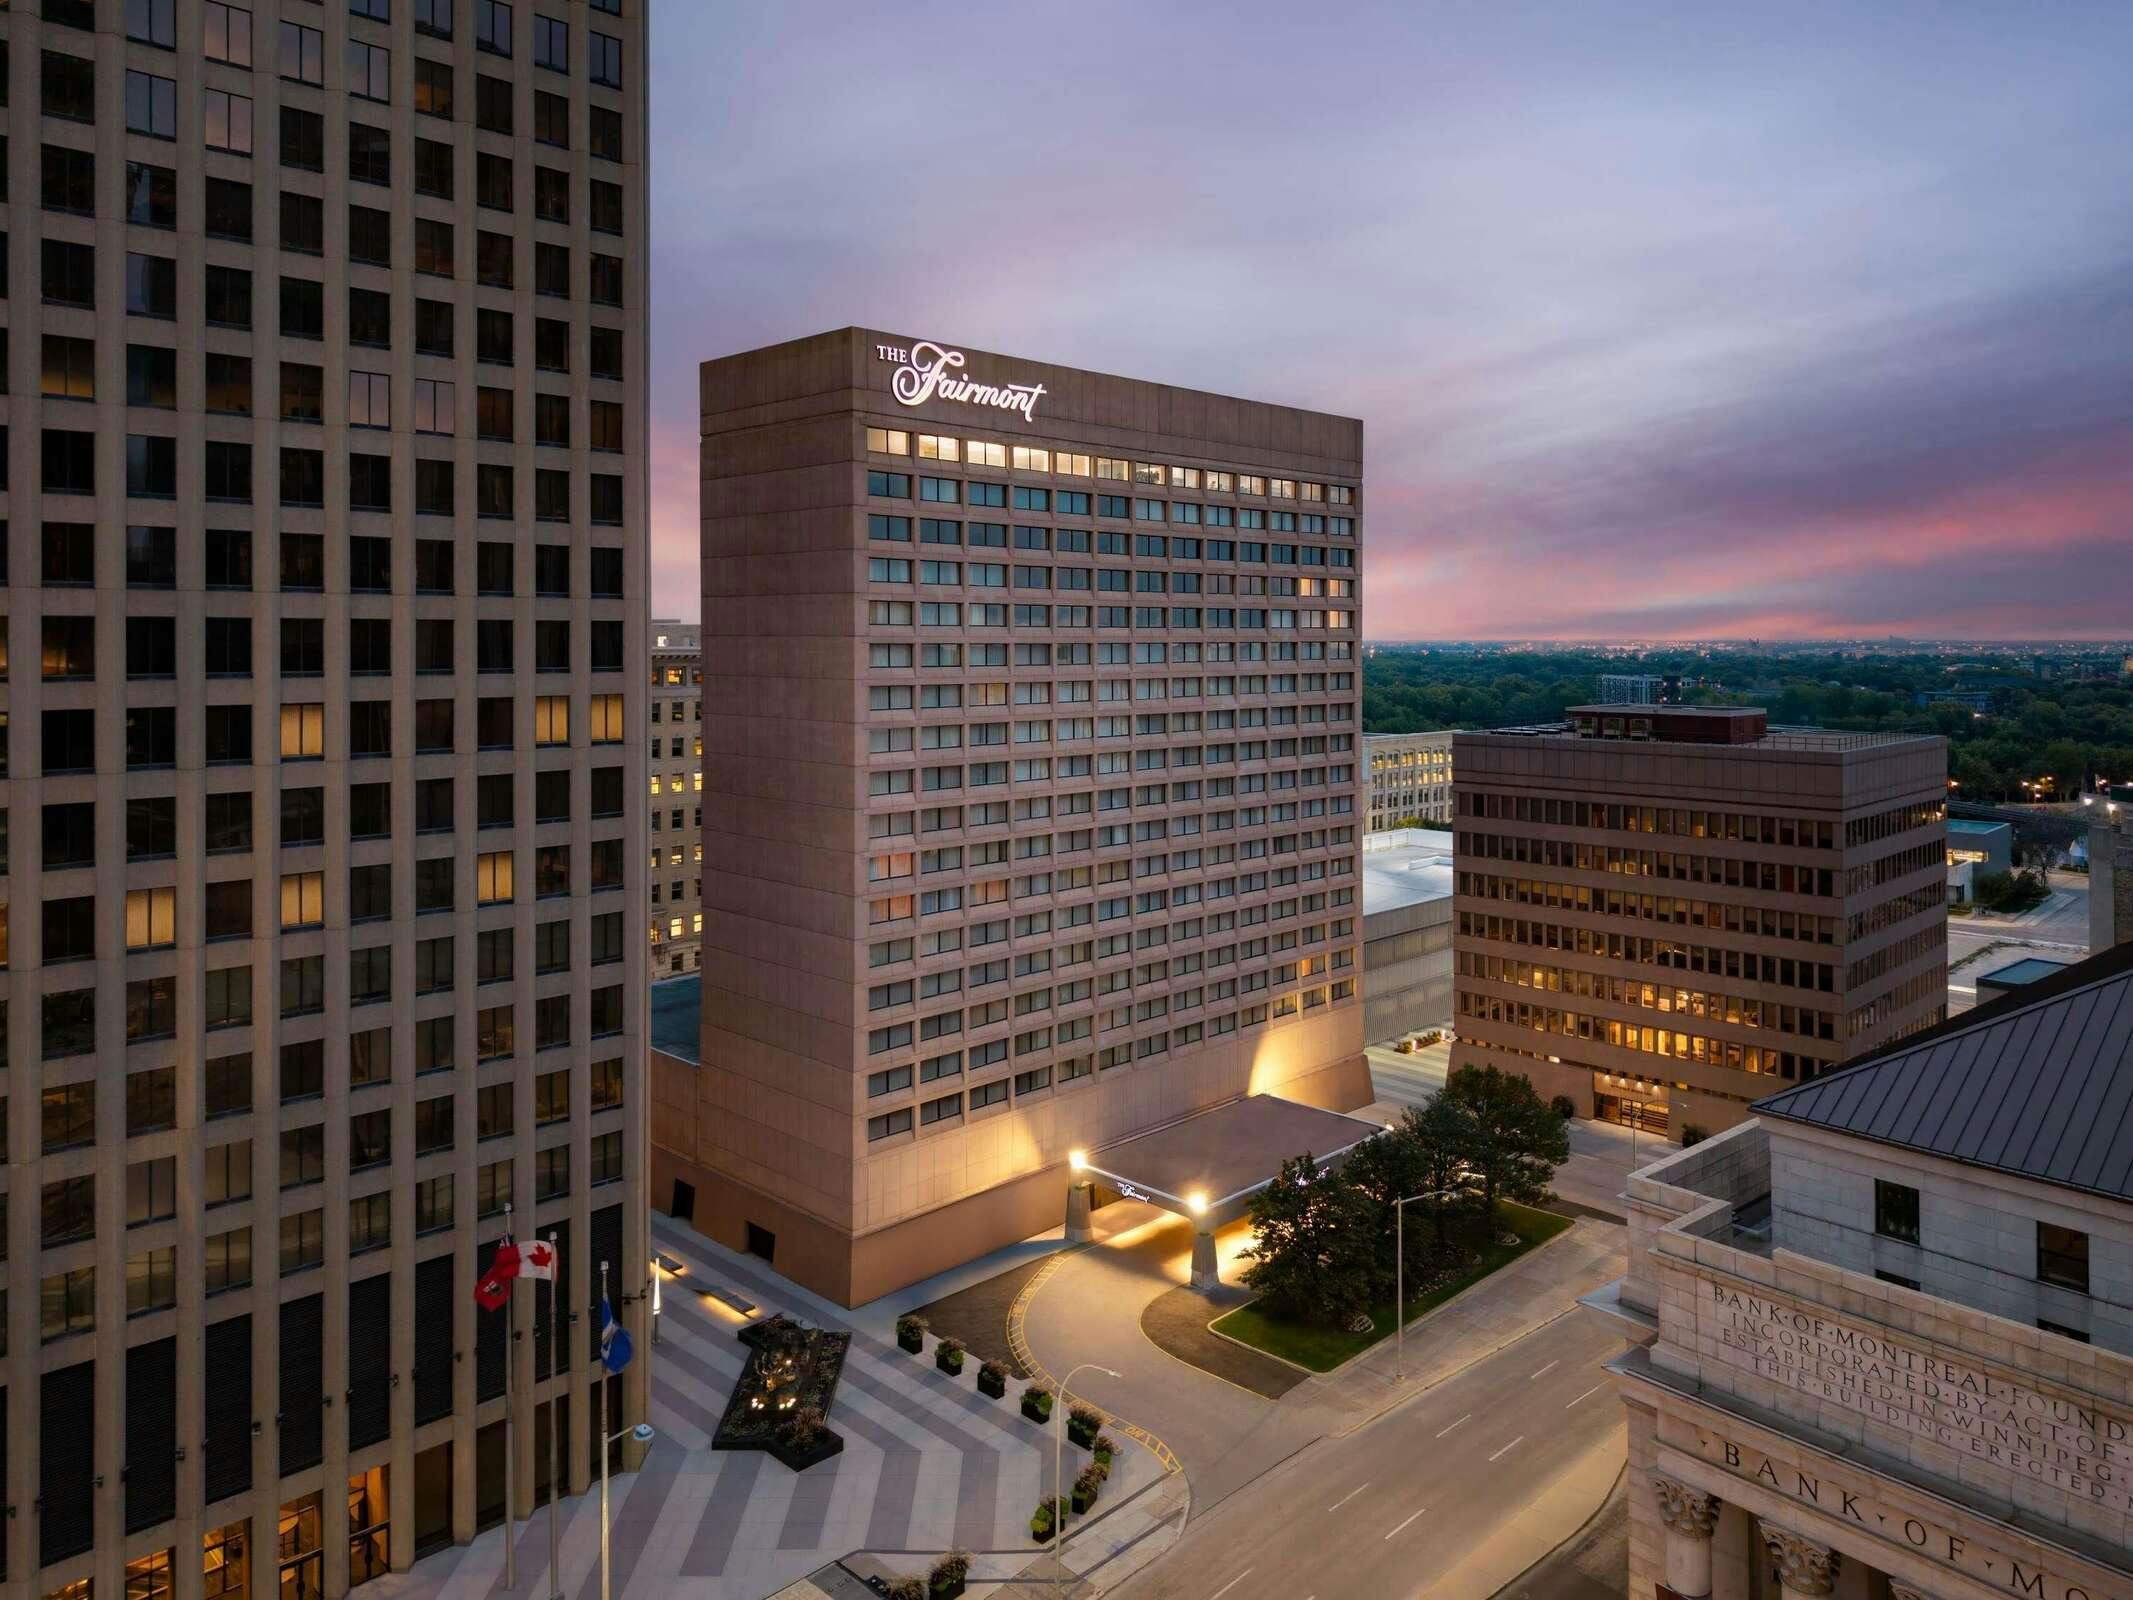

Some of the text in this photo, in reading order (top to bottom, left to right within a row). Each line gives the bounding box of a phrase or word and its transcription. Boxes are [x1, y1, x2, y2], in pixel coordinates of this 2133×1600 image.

[876, 341, 1047, 422] THE Fairmont
[1714, 1285, 2126, 1441] BANK OF MONTREAL FOUND
[1722, 1327, 2112, 1482] ESTABLISHED IN WINNIPEG
[1732, 1312, 2115, 1460] INCORPORATED BY ACT OF
[1752, 1356, 2105, 1498] THIS BUILDING ERECTED
[1723, 1440, 1864, 1522] BANK
[1904, 1518, 1966, 1561] OF
